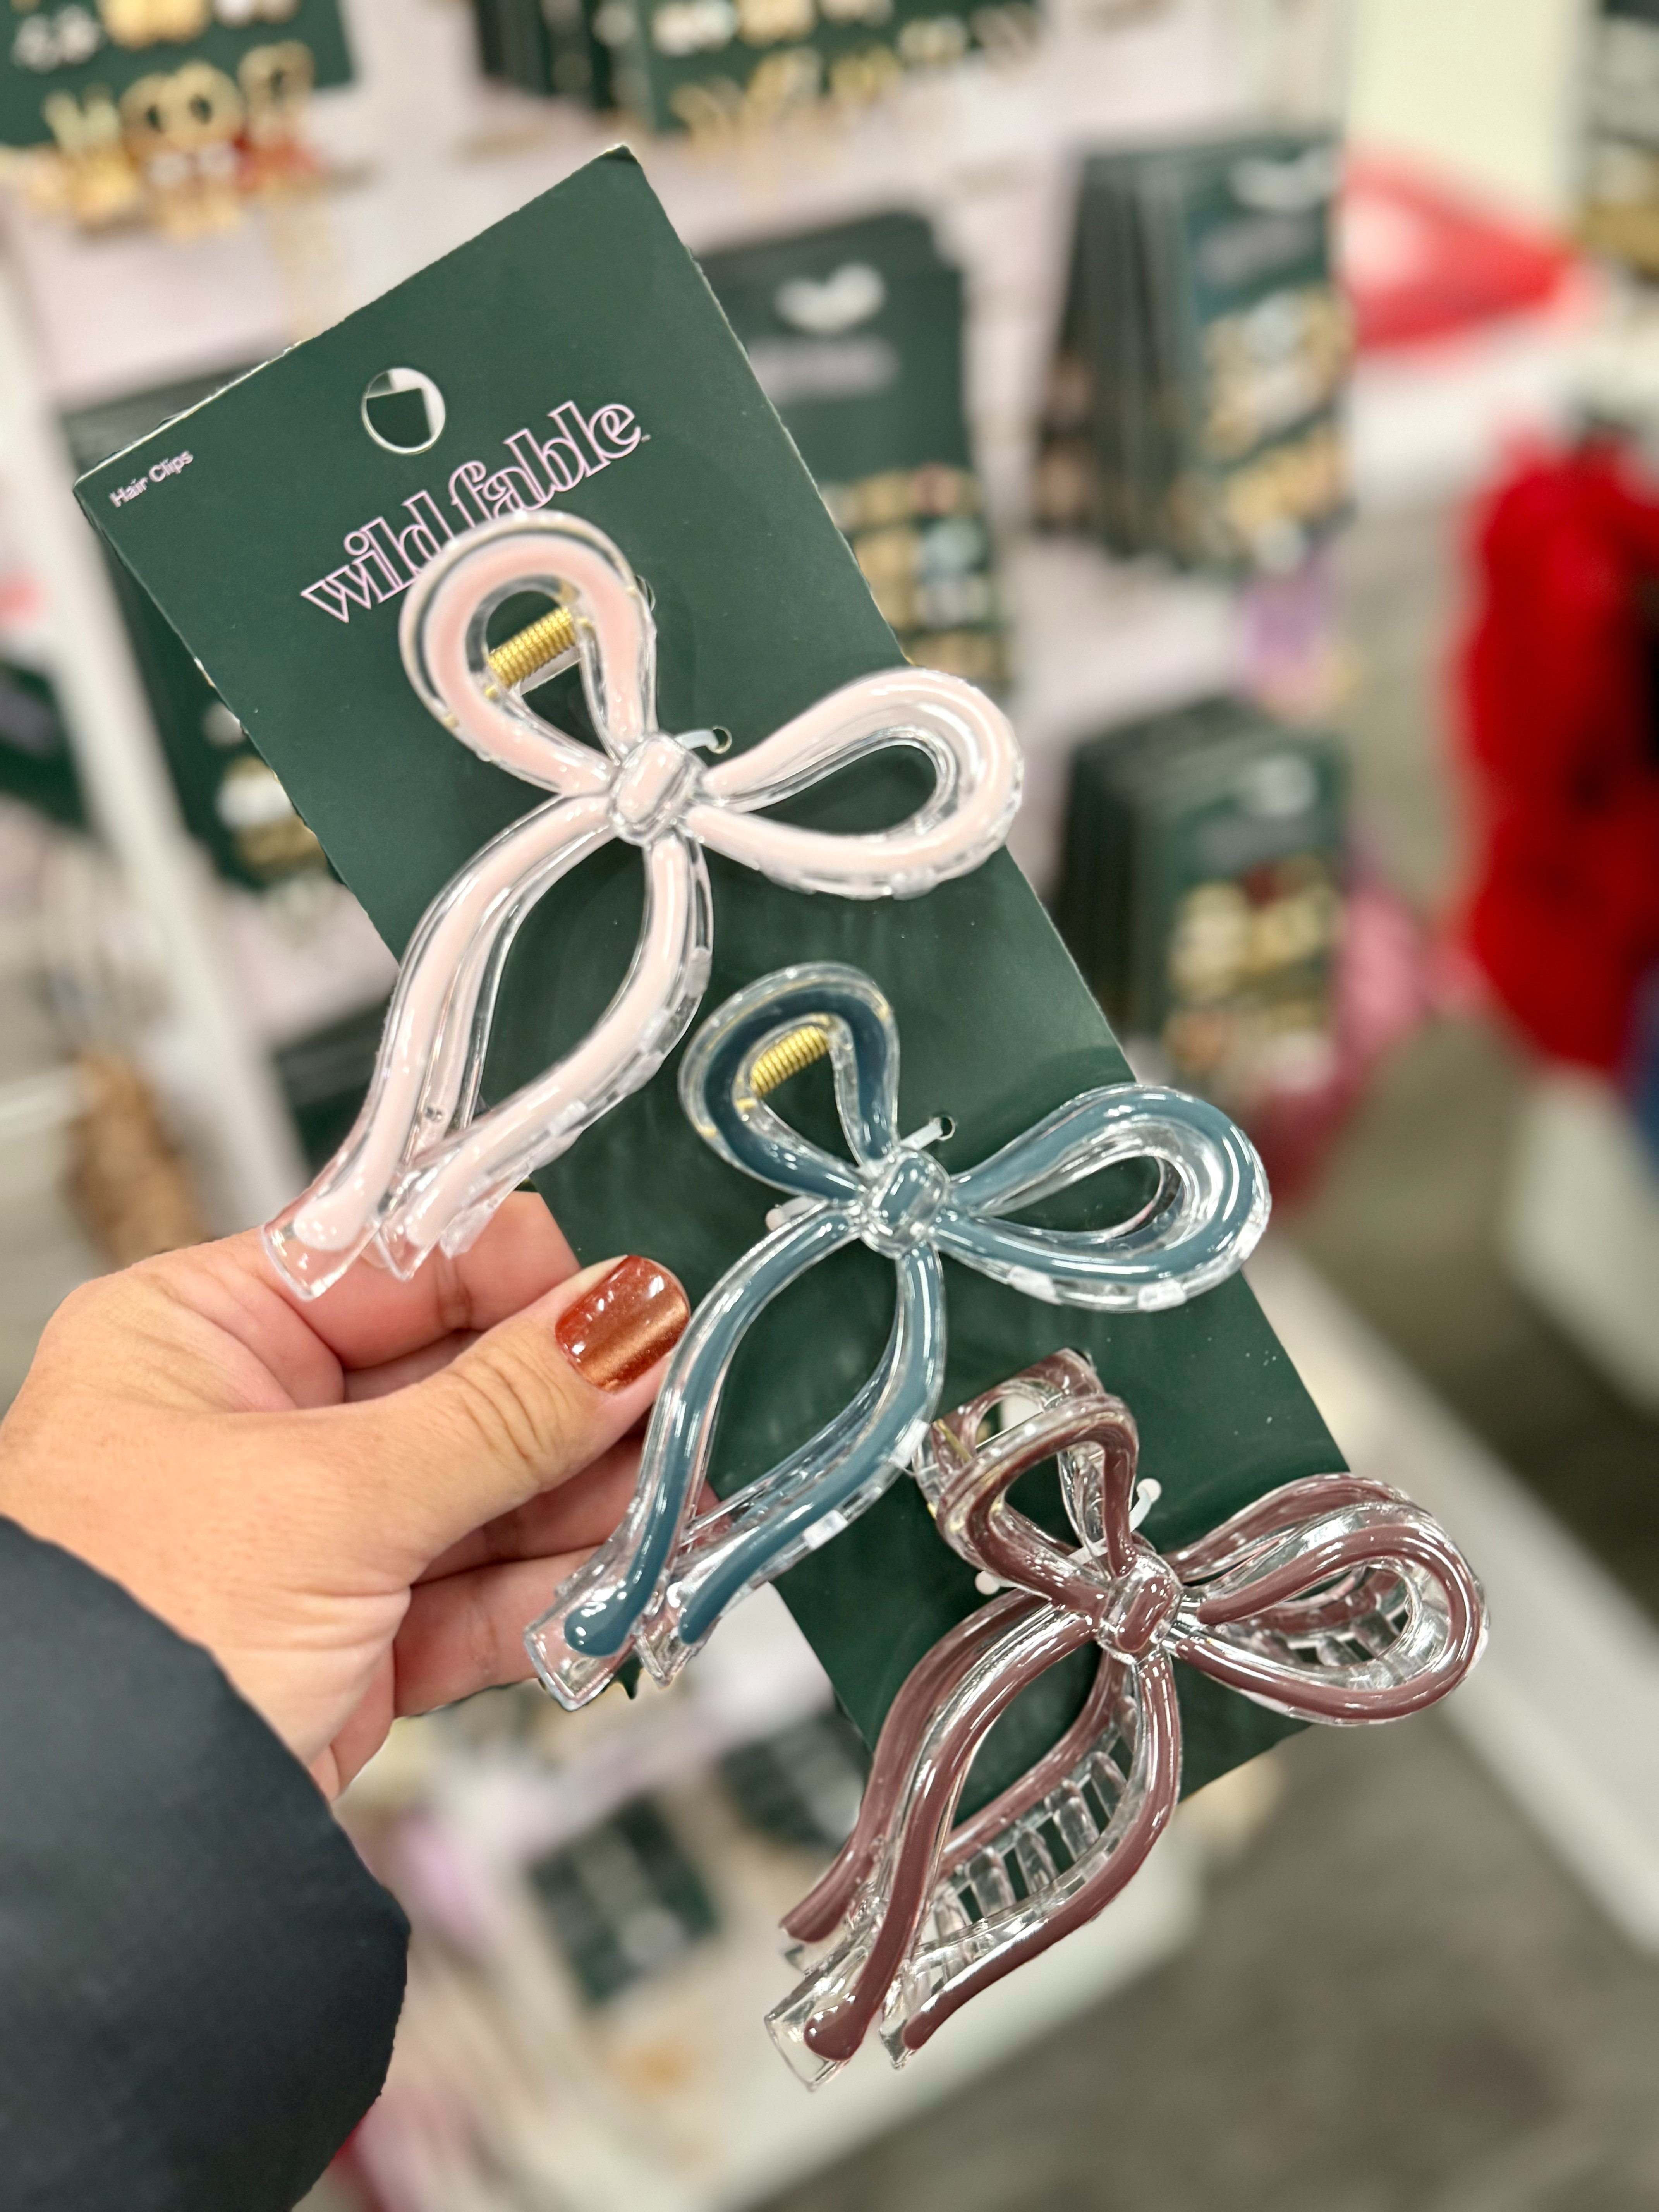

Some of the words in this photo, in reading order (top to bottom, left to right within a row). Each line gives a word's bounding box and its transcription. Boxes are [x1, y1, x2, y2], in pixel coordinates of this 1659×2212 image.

[109, 477, 148, 507] Hair
[149, 451, 193, 482] Clips
[300, 489, 457, 623] wild
[448, 400, 642, 529] fable
